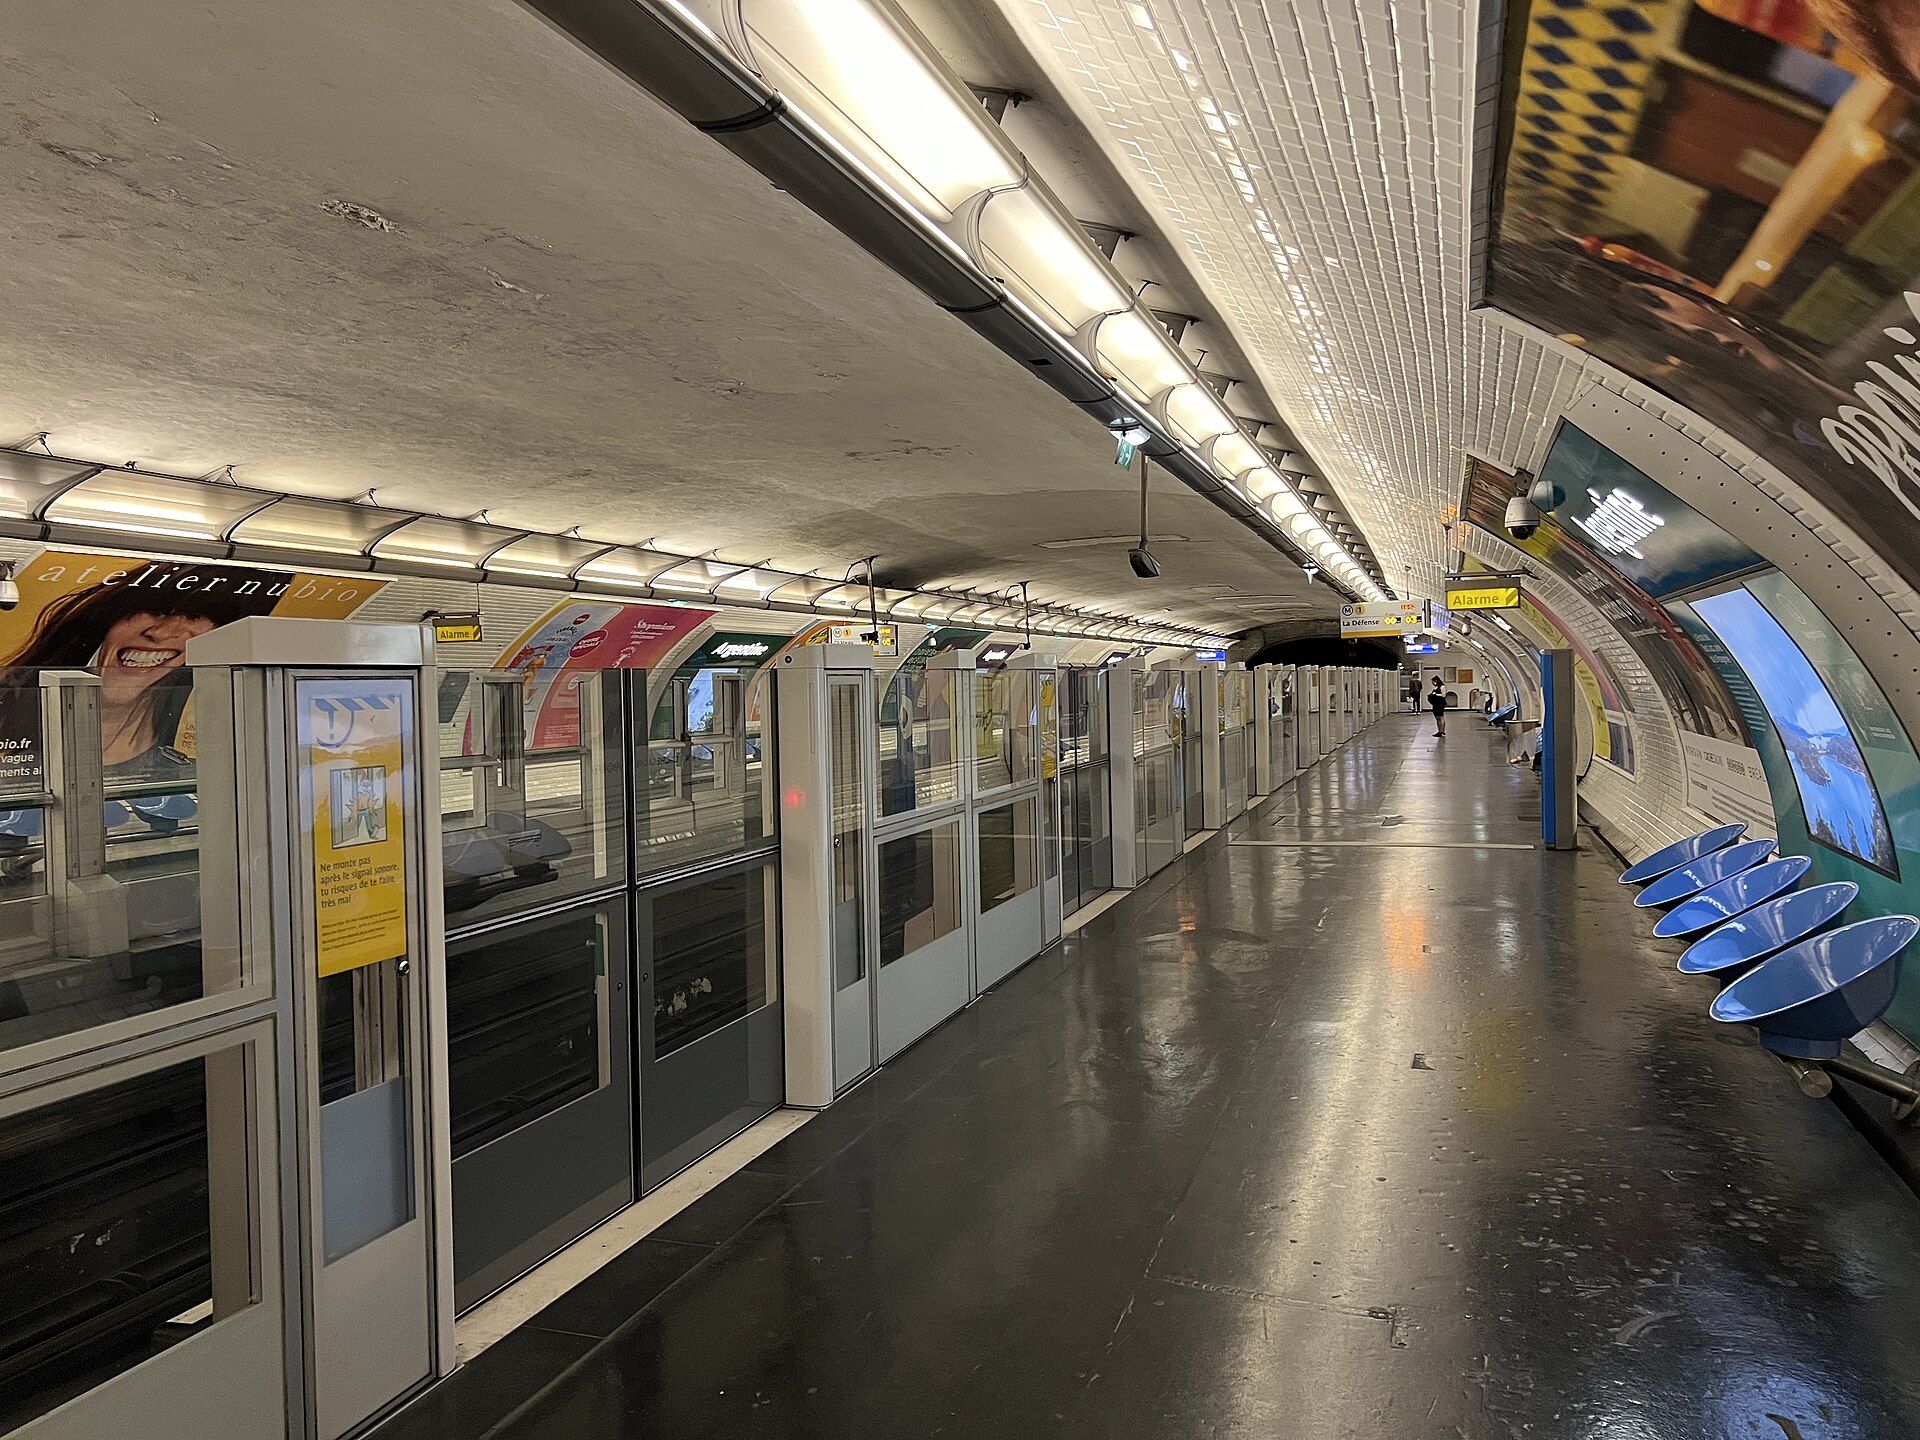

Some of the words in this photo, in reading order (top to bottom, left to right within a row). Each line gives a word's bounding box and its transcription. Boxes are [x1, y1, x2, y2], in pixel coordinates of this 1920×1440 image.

[38, 565, 227, 593] atelier
[1453, 594, 1499, 606] Alarme
[440, 630, 470, 639] Alarme
[710, 641, 769, 659] Argentine
[1, 754, 35, 765] vague
[320, 864, 331, 872] Ne
[333, 860, 356, 869] monte
[359, 856, 371, 867] pas
[320, 874, 341, 885] après
[342, 872, 349, 880] le
[351, 867, 372, 879] signal
[331, 883, 357, 894] risques
[359, 880, 368, 889] de
[370, 879, 377, 887] te
[379, 876, 395, 885] faire
[321, 898, 336, 909] très
[337, 894, 352, 905] mal
